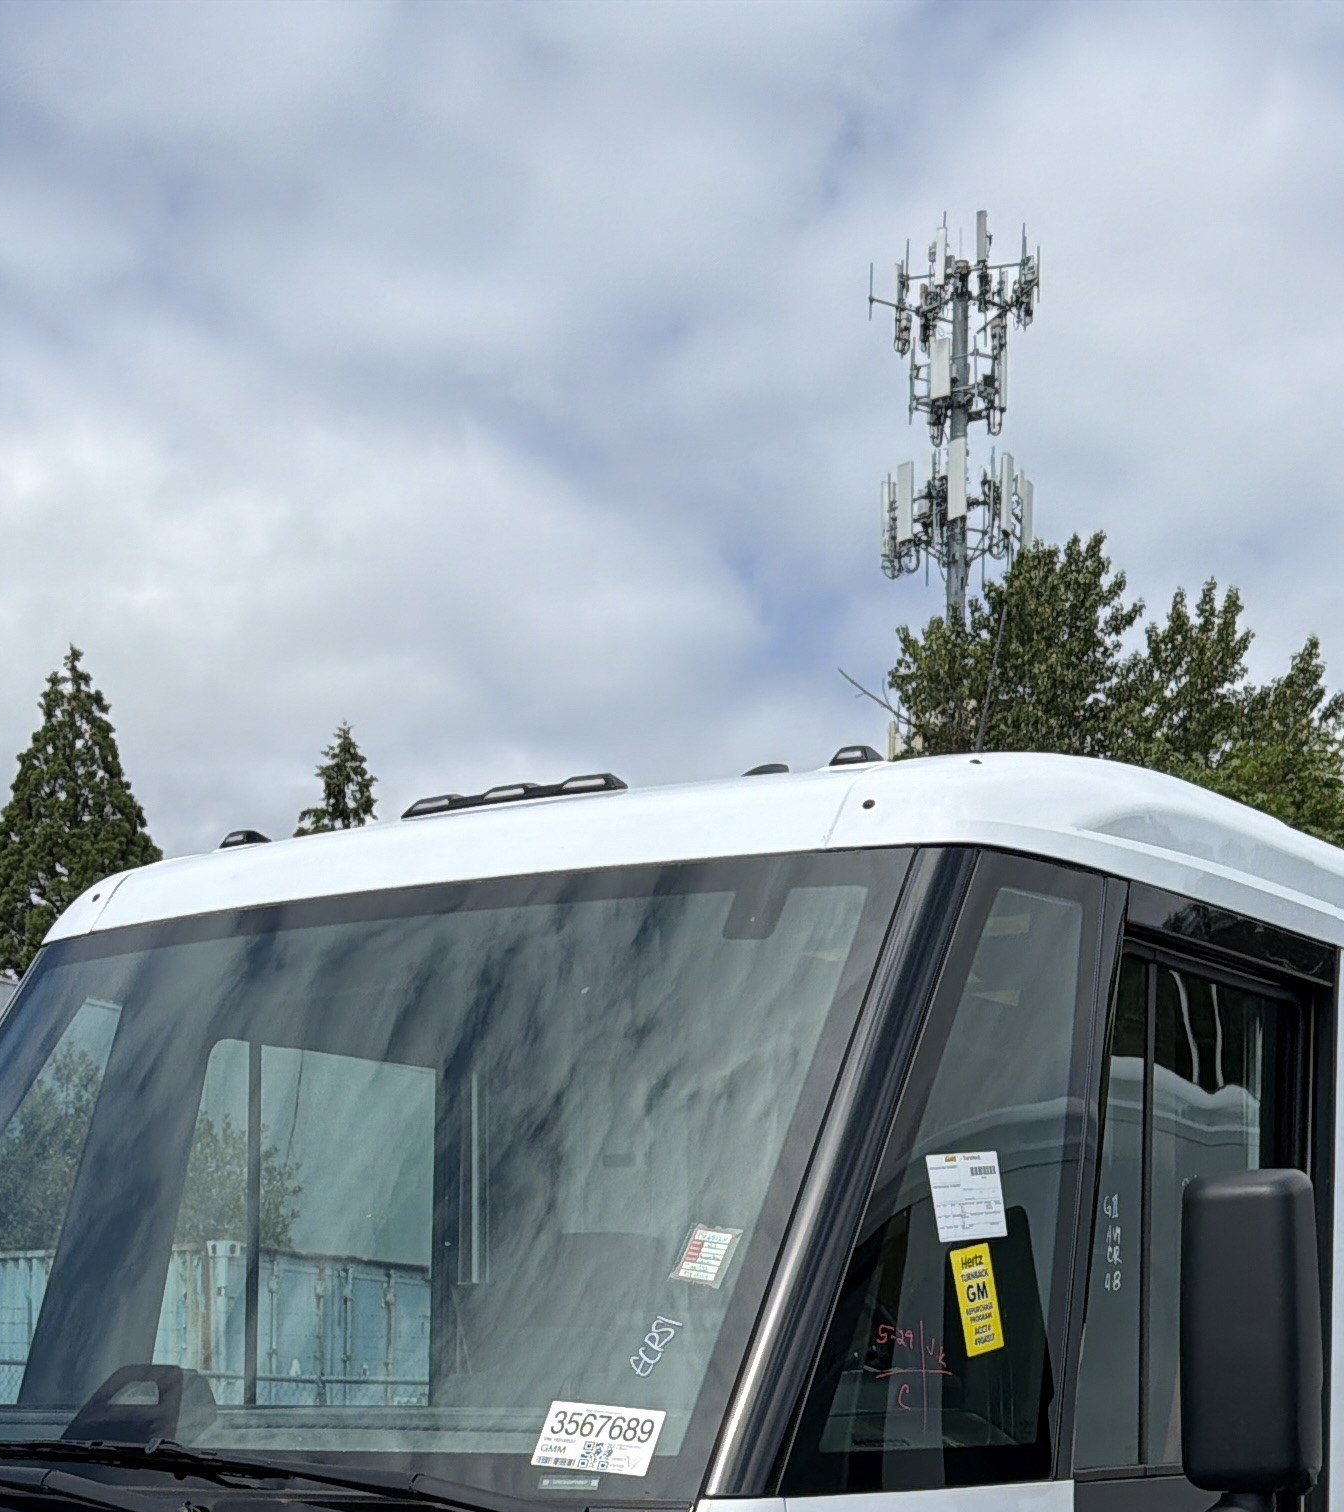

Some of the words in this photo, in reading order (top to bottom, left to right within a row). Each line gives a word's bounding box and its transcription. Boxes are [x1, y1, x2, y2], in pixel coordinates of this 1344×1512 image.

[961, 1253, 984, 1270] Hertz
[966, 1281, 989, 1303] GM
[550, 1410, 655, 1443] 3567689
[540, 1444, 567, 1455] GMM
